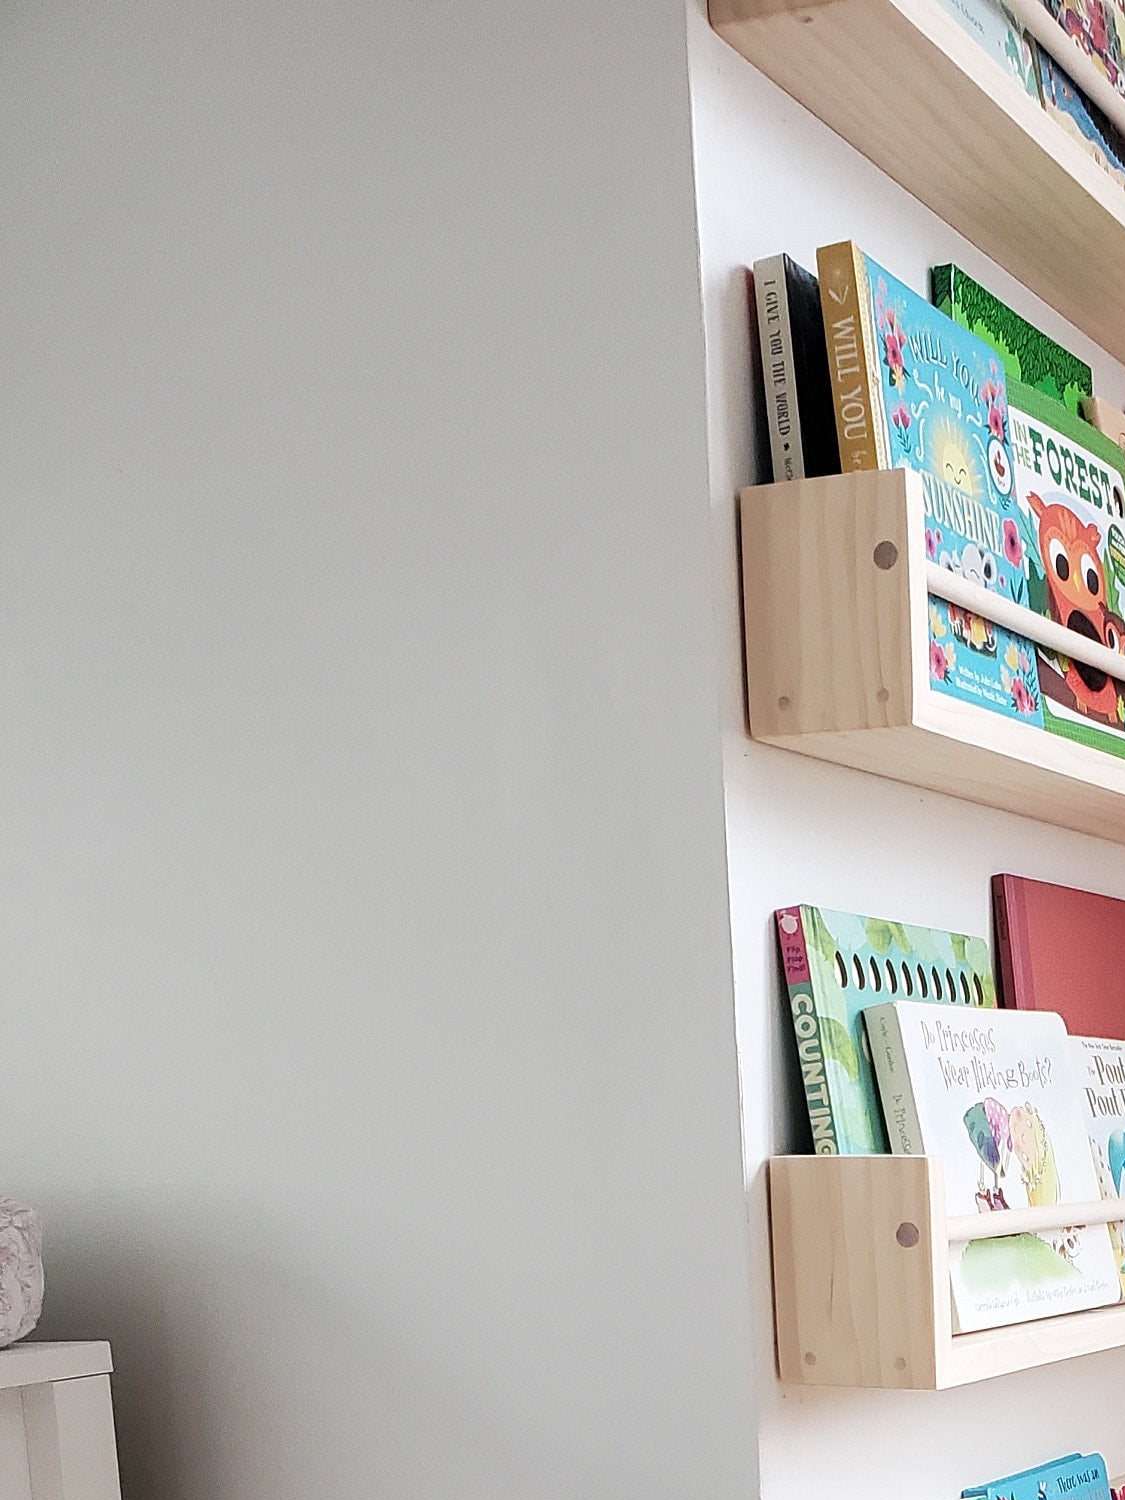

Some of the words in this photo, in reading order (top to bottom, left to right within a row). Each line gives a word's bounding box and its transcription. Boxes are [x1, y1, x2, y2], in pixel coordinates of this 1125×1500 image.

[766, 292, 781, 326] GIVE
[769, 329, 784, 356] YOU
[832, 315, 861, 382] WILL
[772, 360, 787, 388] THE
[908, 331, 948, 369] WILL
[951, 350, 981, 408] YOU
[775, 392, 791, 436] WORLD
[840, 385, 868, 439] YOU
[1013, 419, 1028, 445] IN
[1029, 426, 1113, 517] FOREST
[920, 469, 1004, 558] SUNSHINE
[920, 1020, 936, 1050] Do
[935, 1020, 996, 1056] Princesses
[938, 1056, 970, 1092] Wear
[970, 1055, 1018, 1093] Hiking
[1017, 1055, 1053, 1089] Boots?
[1083, 1087, 1122, 1118] Pout
[1056, 1475, 1077, 1494] There
